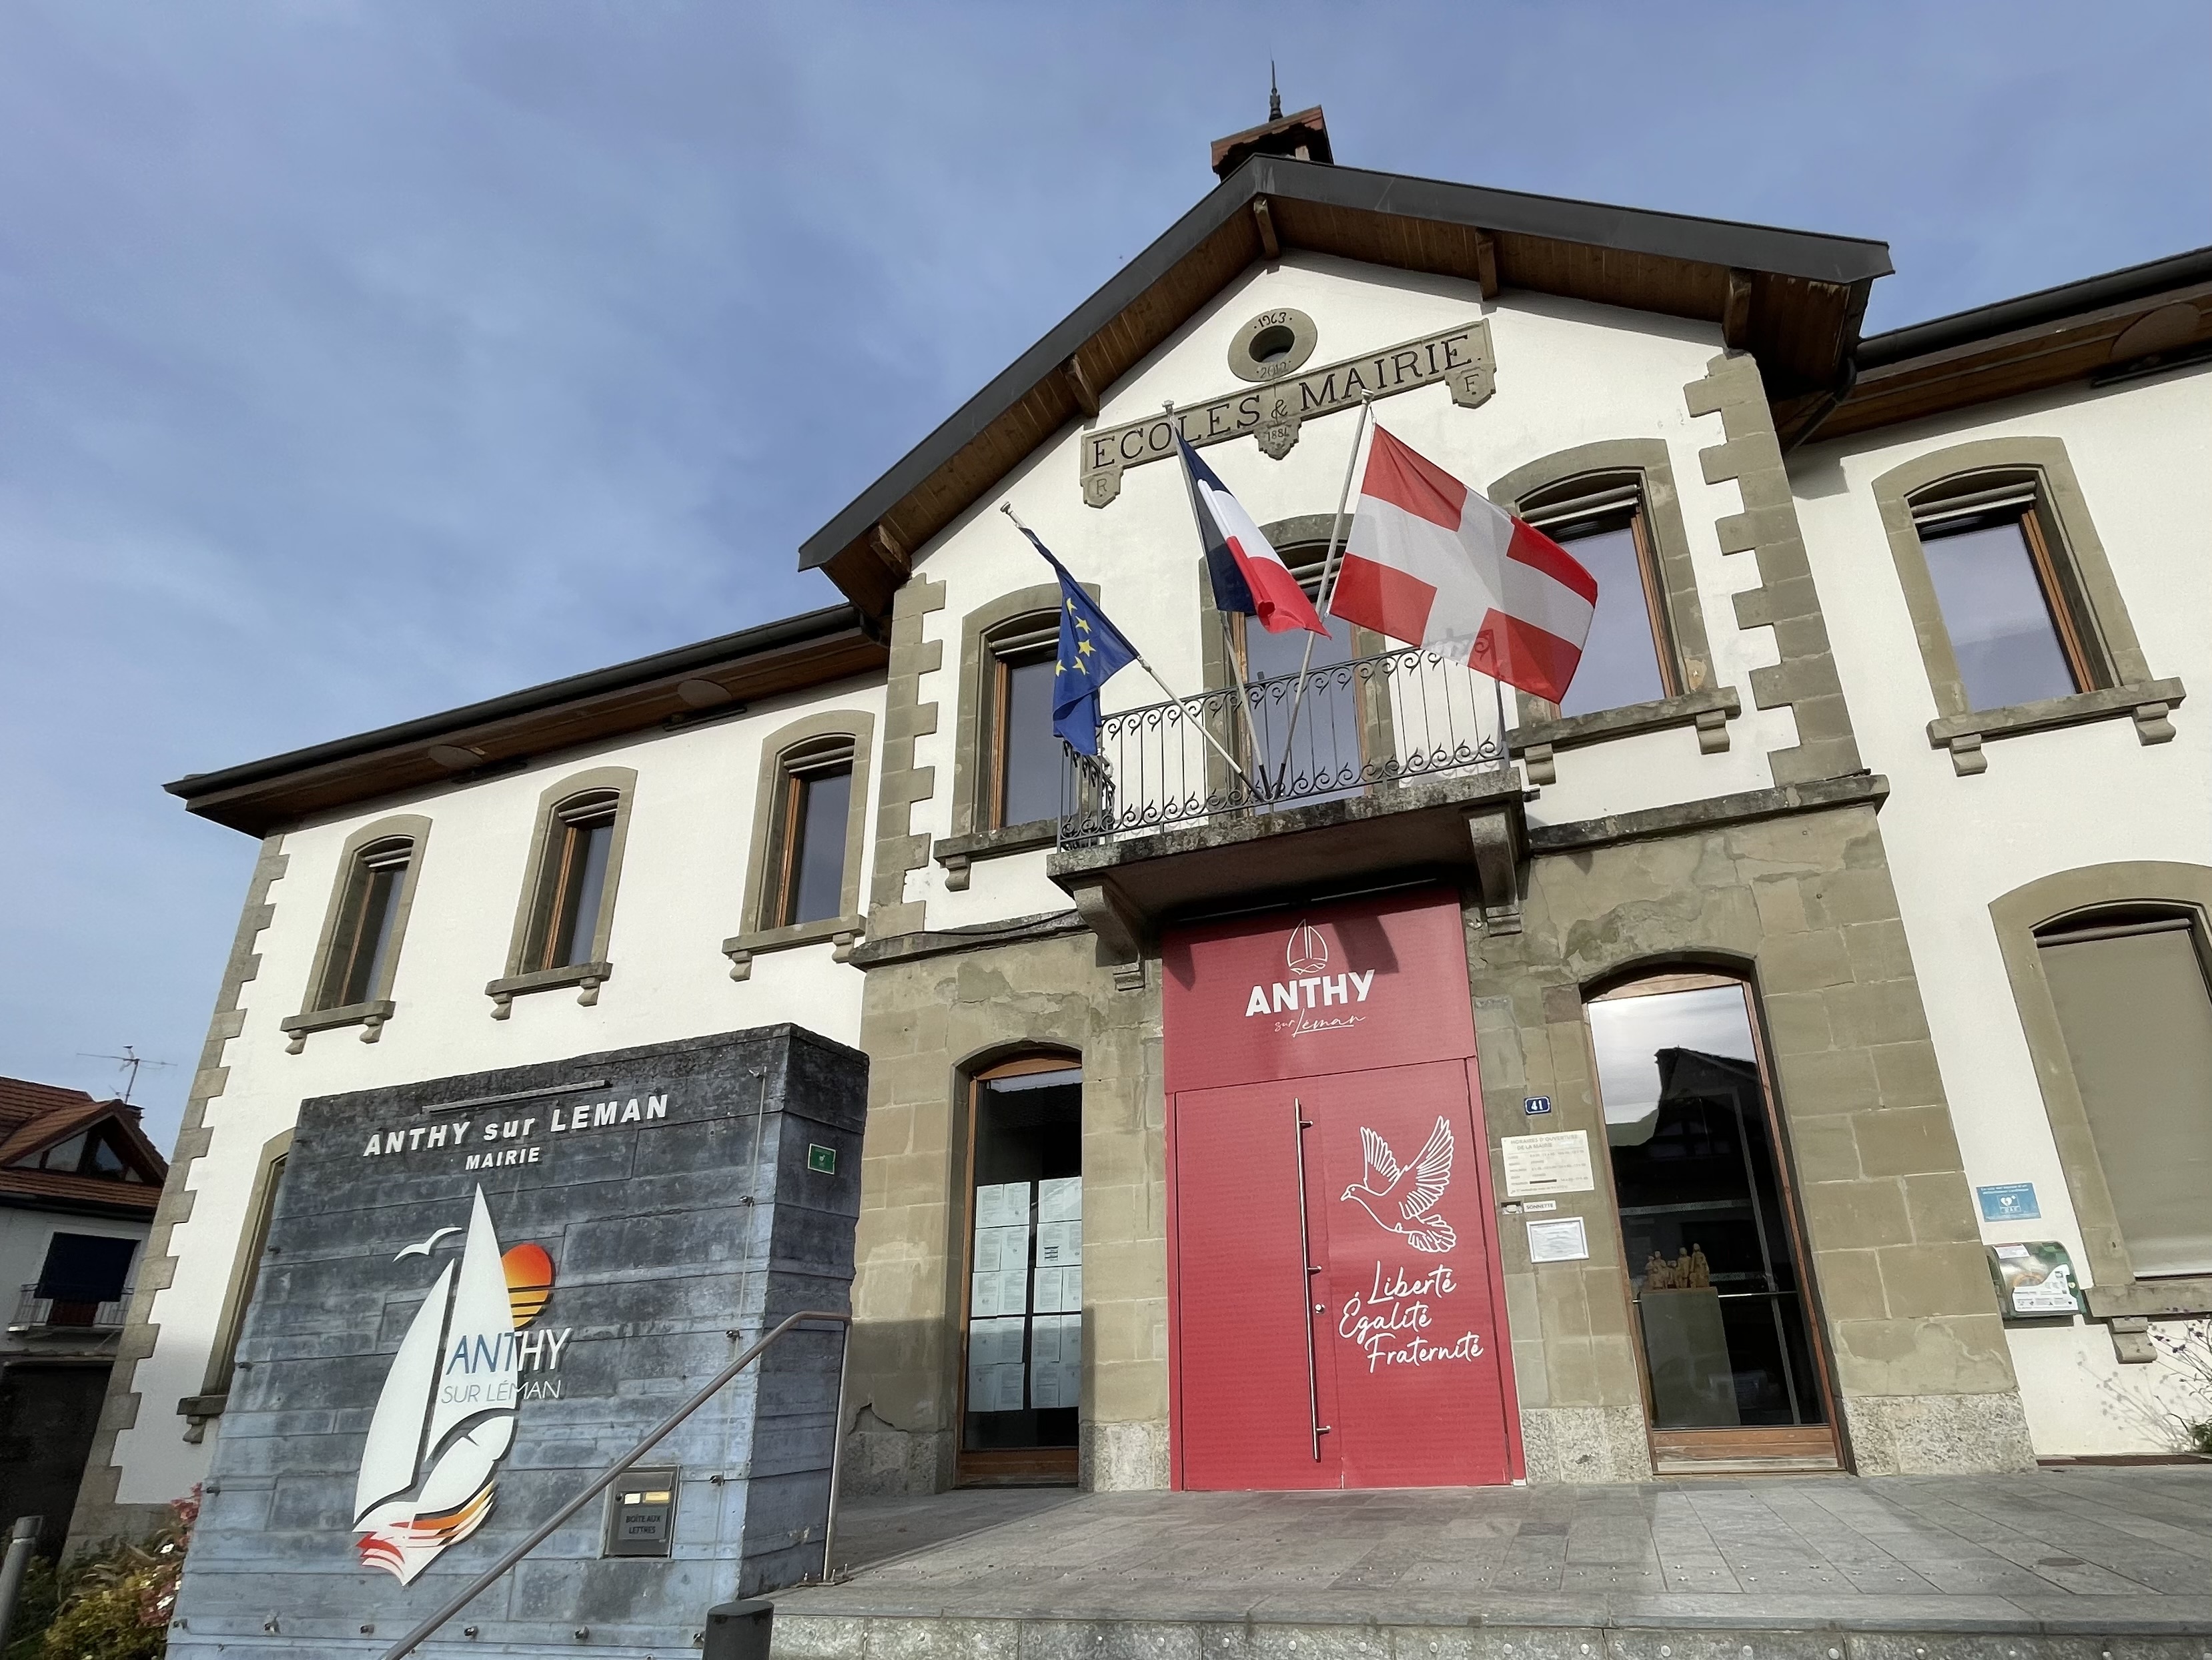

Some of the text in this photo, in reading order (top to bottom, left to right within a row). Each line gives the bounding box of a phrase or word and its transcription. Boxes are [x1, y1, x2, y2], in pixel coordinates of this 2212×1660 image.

[1092, 395, 1260, 469] ECOLES
[1271, 399, 1288, 419] &
[1245, 969, 1375, 1017] ANTHY
[1274, 1019, 1296, 1032] sur
[363, 1094, 668, 1158] ANTHY sur LEMAN
[1531, 1100, 1544, 1111] 41
[465, 1147, 541, 1170] MAIRIE
[1367, 1260, 1457, 1304] Liberté
[1339, 1291, 1432, 1344] Égalité
[446, 1328, 572, 1375] ANTHY
[1364, 1331, 1484, 1373] Fraternité
[441, 1380, 562, 1404] SUR LÉMAN
[628, 1526, 656, 1534] LETTRES
